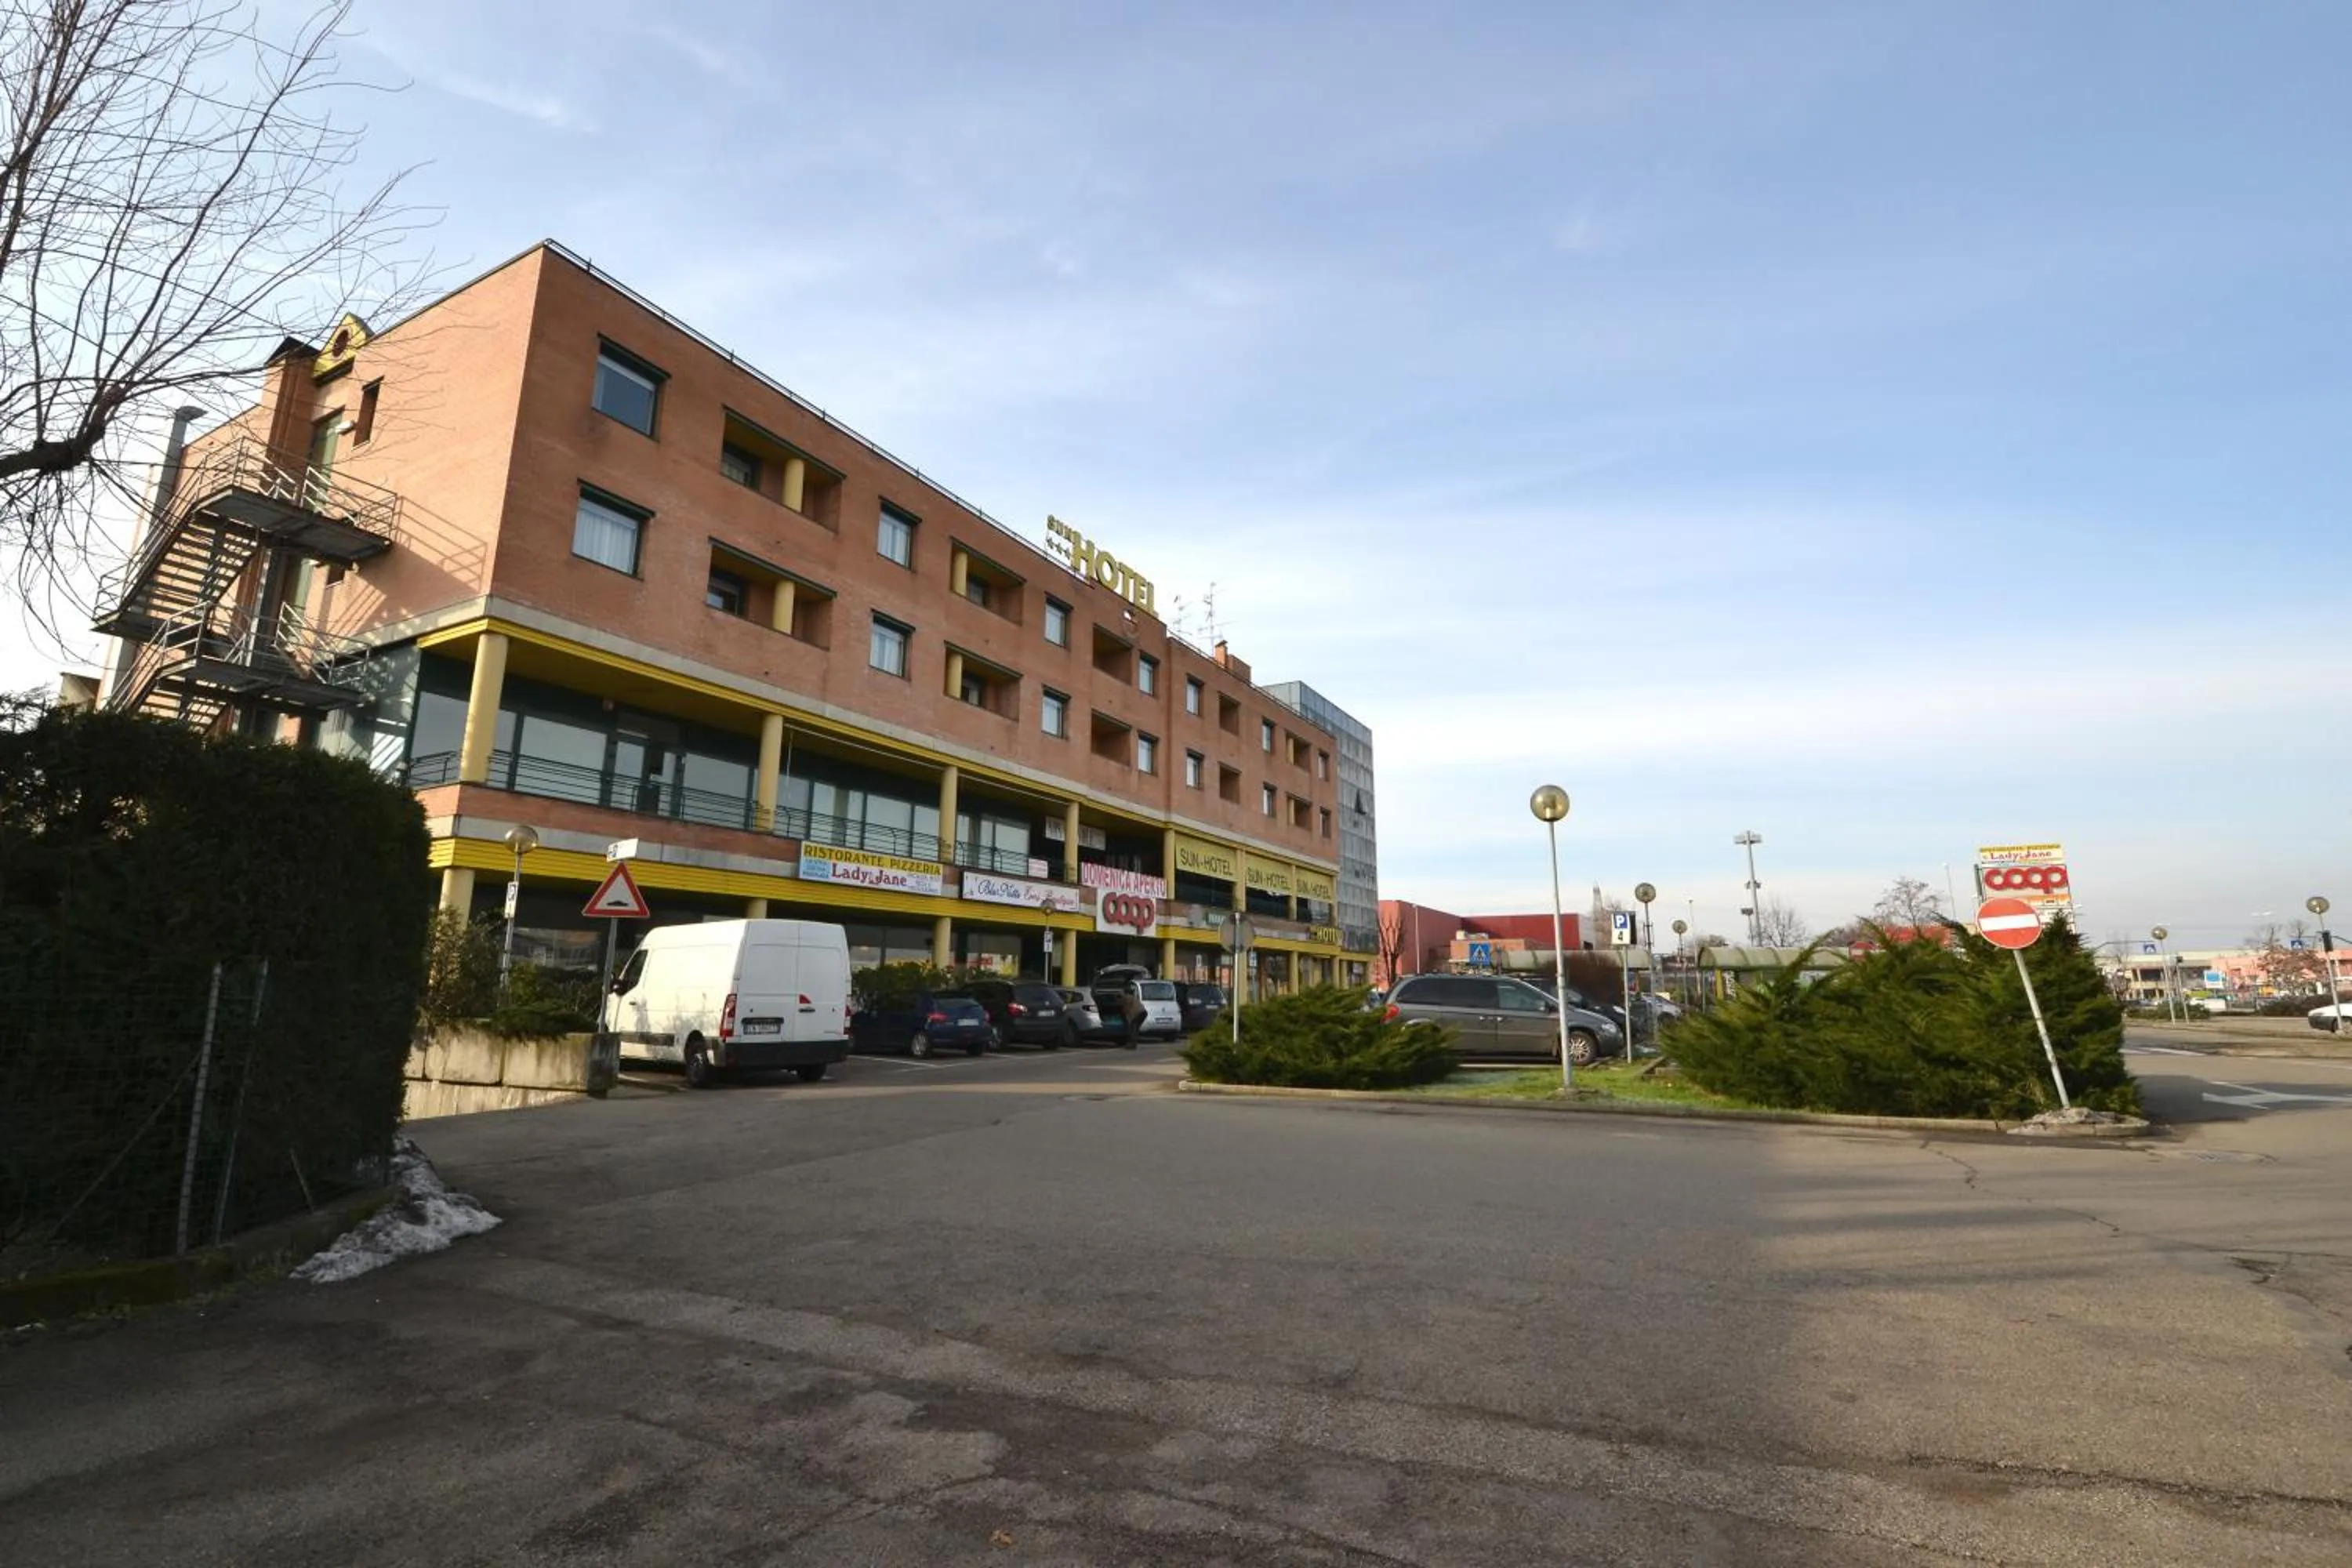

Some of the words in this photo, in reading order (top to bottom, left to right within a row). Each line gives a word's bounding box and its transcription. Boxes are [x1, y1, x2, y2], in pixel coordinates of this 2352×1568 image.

[1072, 531, 1159, 618] HOTEL
[804, 844, 884, 867] RISTORANTE
[890, 858, 941, 876] PIZZERIA
[832, 862, 868, 884] Lady
[875, 869, 907, 887] Jane
[1180, 848, 1233, 876] SUN-HOTEL
[1082, 862, 1132, 892] DOMENICA
[1133, 873, 1166, 899] APERTO
[1984, 866, 2067, 894] coop
[1102, 891, 1155, 935] coop
[1615, 915, 1625, 928] P
